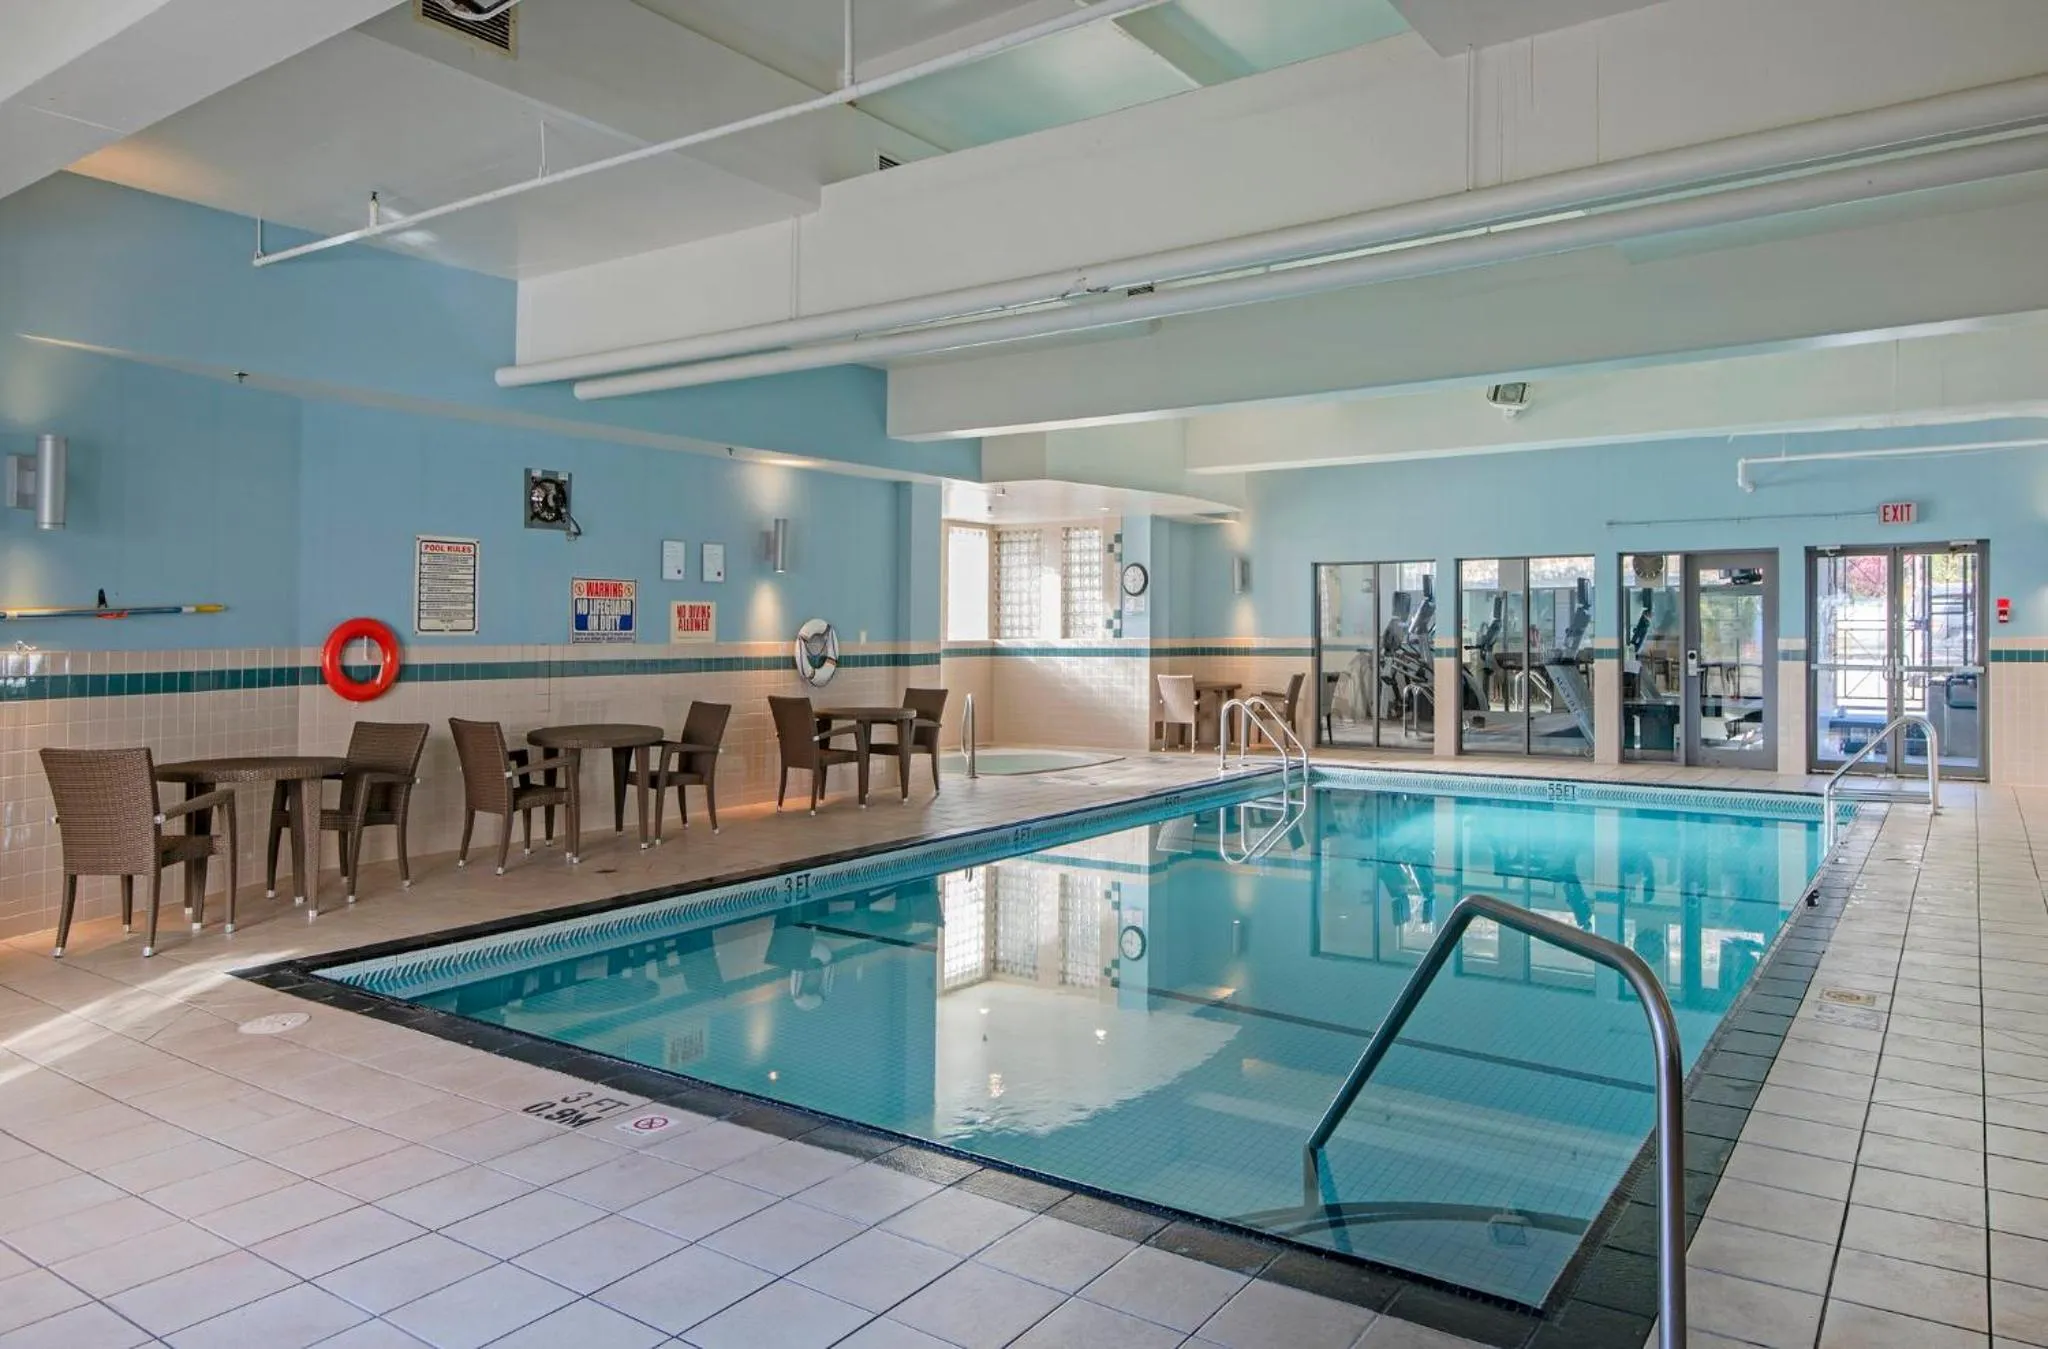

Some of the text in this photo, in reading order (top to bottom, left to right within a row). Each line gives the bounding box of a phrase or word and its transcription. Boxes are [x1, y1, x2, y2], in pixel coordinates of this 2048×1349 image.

[1883, 504, 1912, 522] EXIT
[424, 544, 473, 554] POOL RULES
[587, 581, 624, 598] WARNING
[576, 599, 631, 616] NO LIFEGUARD
[676, 604, 711, 618] NO DIVING
[587, 615, 621, 631] ON DUTY
[678, 619, 710, 632] ALLOWED
[784, 873, 811, 893] 3 FT
[560, 1091, 630, 1113] 3 FT
[522, 1101, 602, 1128] 0.9M
